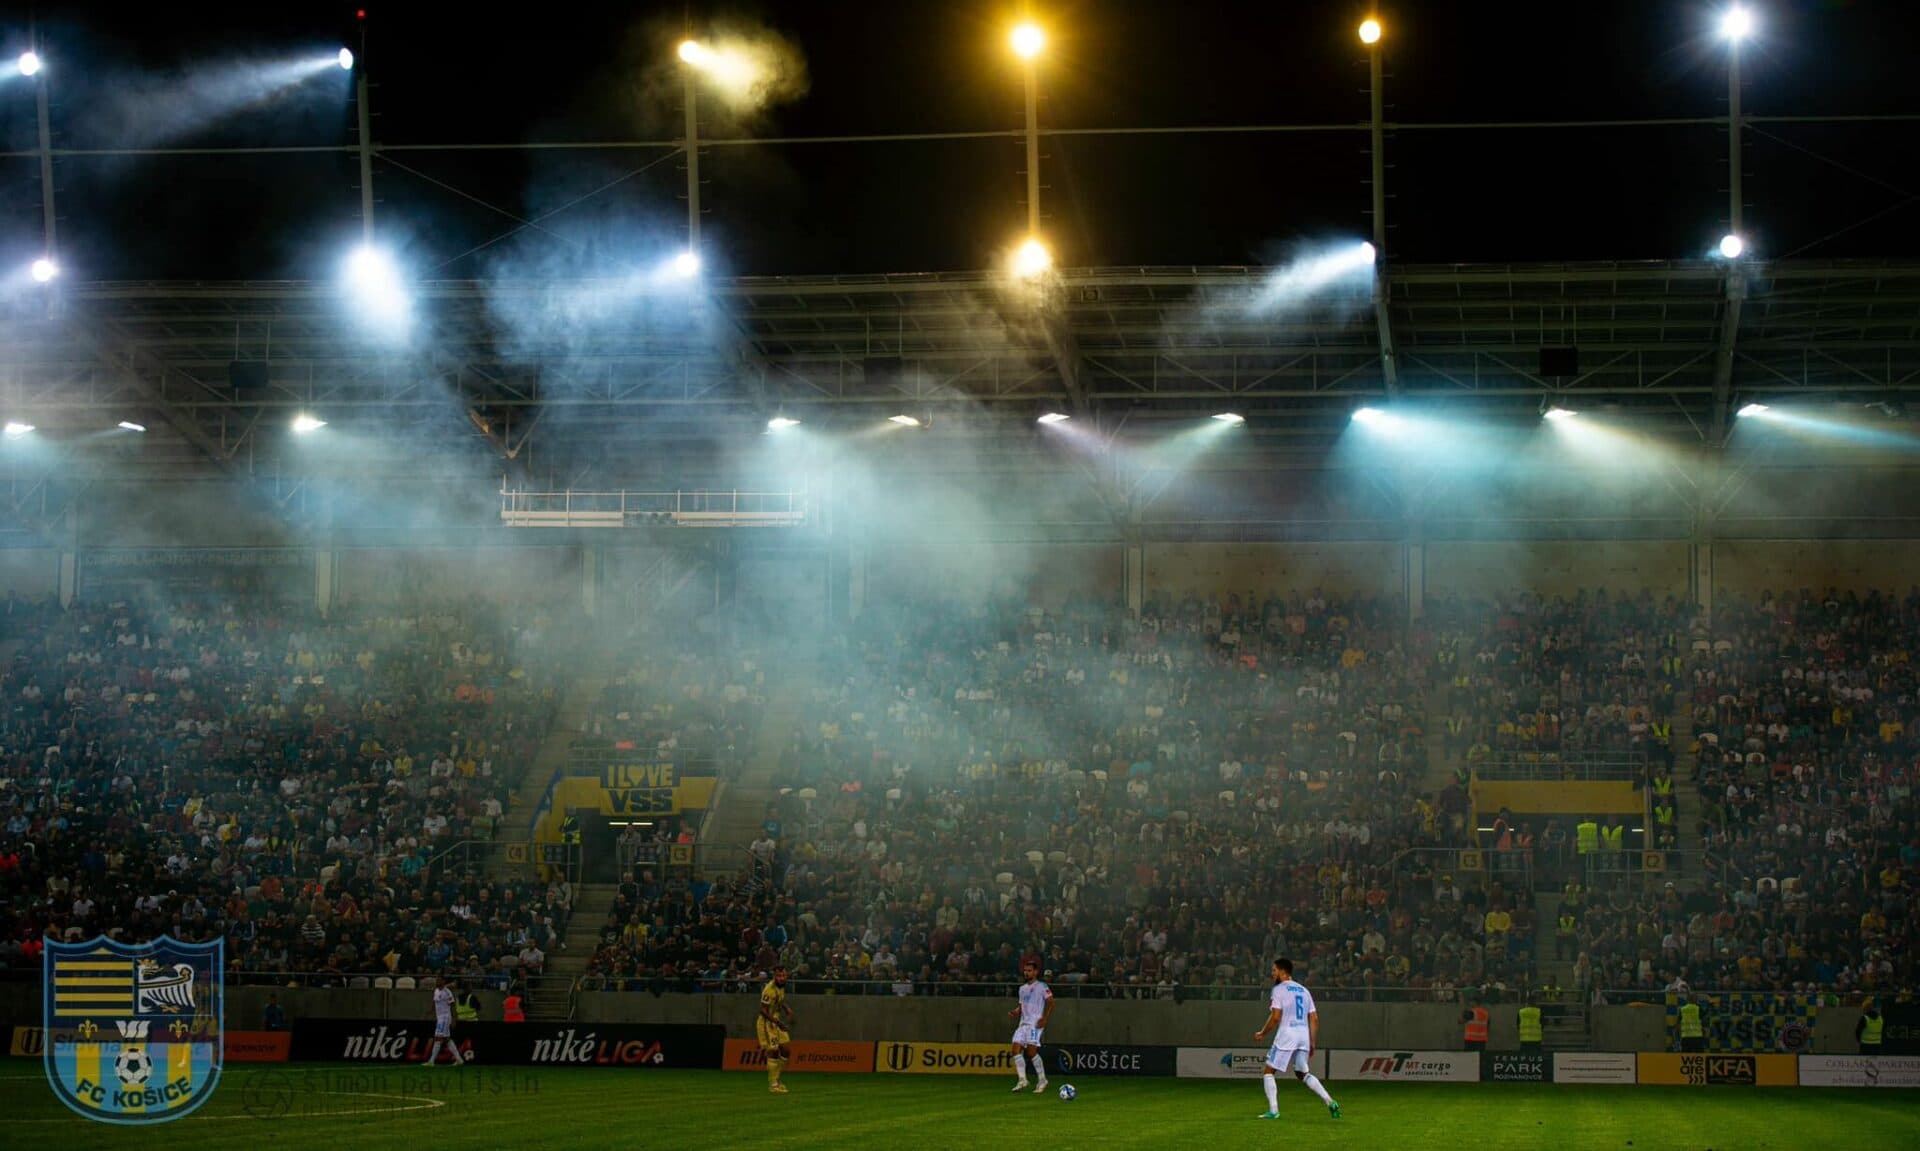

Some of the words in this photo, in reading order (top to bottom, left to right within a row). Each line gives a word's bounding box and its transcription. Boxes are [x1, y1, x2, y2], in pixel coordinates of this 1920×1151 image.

[609, 788, 674, 813] VSS
[1295, 995, 1304, 1020] 6
[343, 1026, 408, 1060] niké
[530, 1029, 597, 1064] niké
[595, 1039, 664, 1065] LIGA
[922, 1049, 1013, 1069] Slovnaft
[1076, 1050, 1141, 1070] KOŠICE
[1422, 1063, 1451, 1071] cargo
[1493, 1063, 1542, 1073] PARK
[1681, 1055, 1704, 1065] we
[1709, 1058, 1753, 1076] KFA
[1680, 1065, 1704, 1076] are
